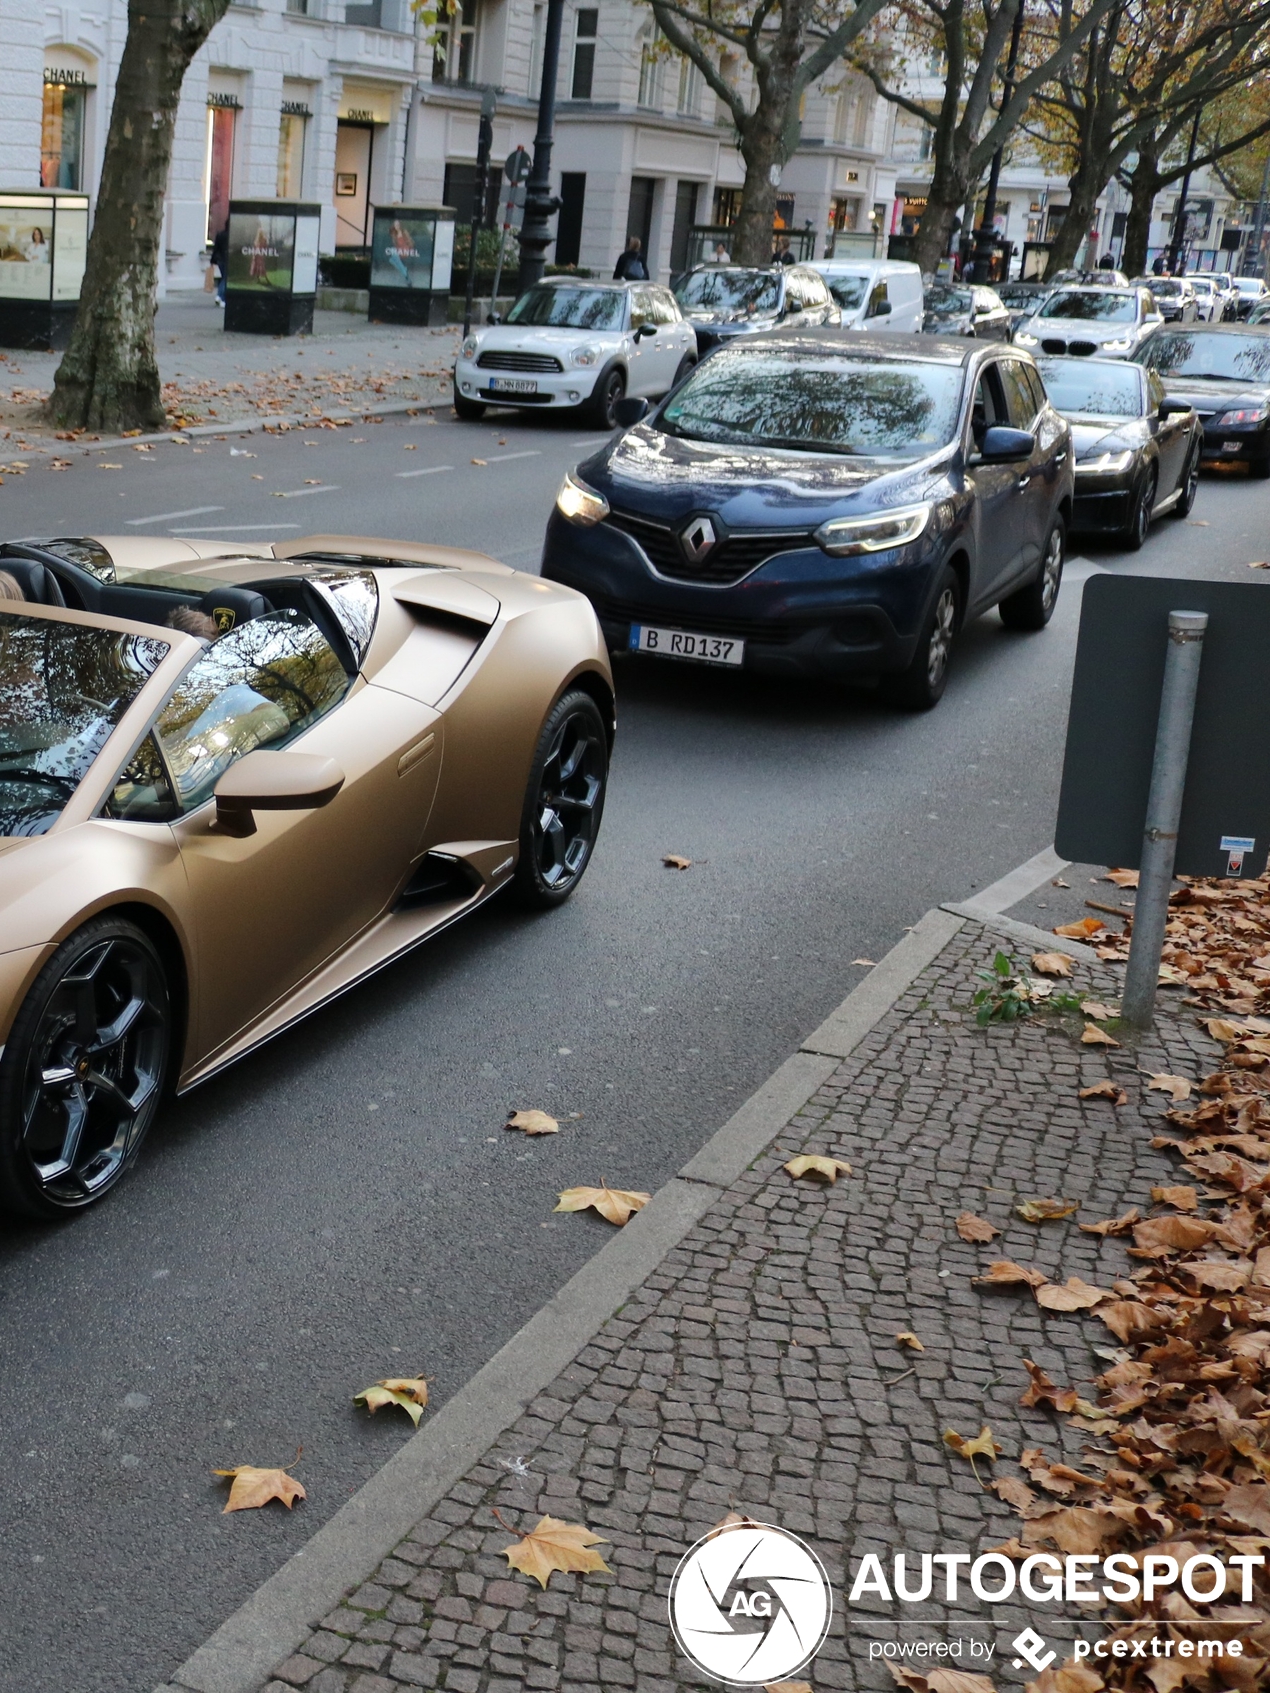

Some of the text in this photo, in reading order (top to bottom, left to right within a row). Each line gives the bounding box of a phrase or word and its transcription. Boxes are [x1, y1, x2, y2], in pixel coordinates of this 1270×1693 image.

[43, 67, 86, 84] CHANEL
[207, 92, 239, 106] CHANEL
[281, 99, 309, 113] CHANEL
[347, 108, 374, 121] CHANEL
[241, 246, 279, 257] CHANEL
[385, 246, 420, 258] CHANEL
[646, 630, 659, 649] B
